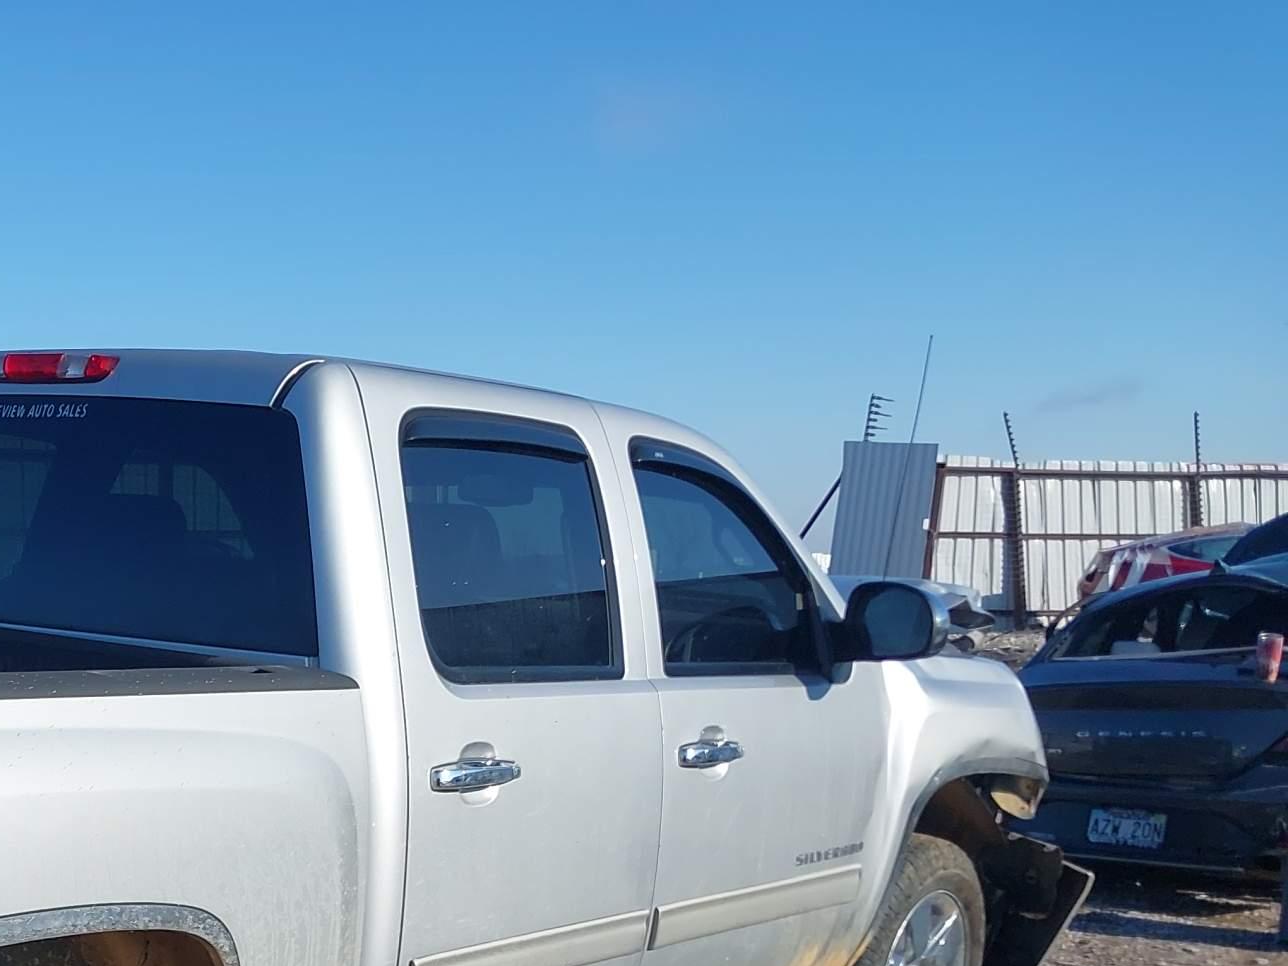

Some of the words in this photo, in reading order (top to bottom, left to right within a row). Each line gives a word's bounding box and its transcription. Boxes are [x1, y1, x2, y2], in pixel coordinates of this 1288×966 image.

[27, 403, 55, 418] AUTO
[56, 403, 89, 418] SALES
[1076, 731, 1207, 739] GENESIS
